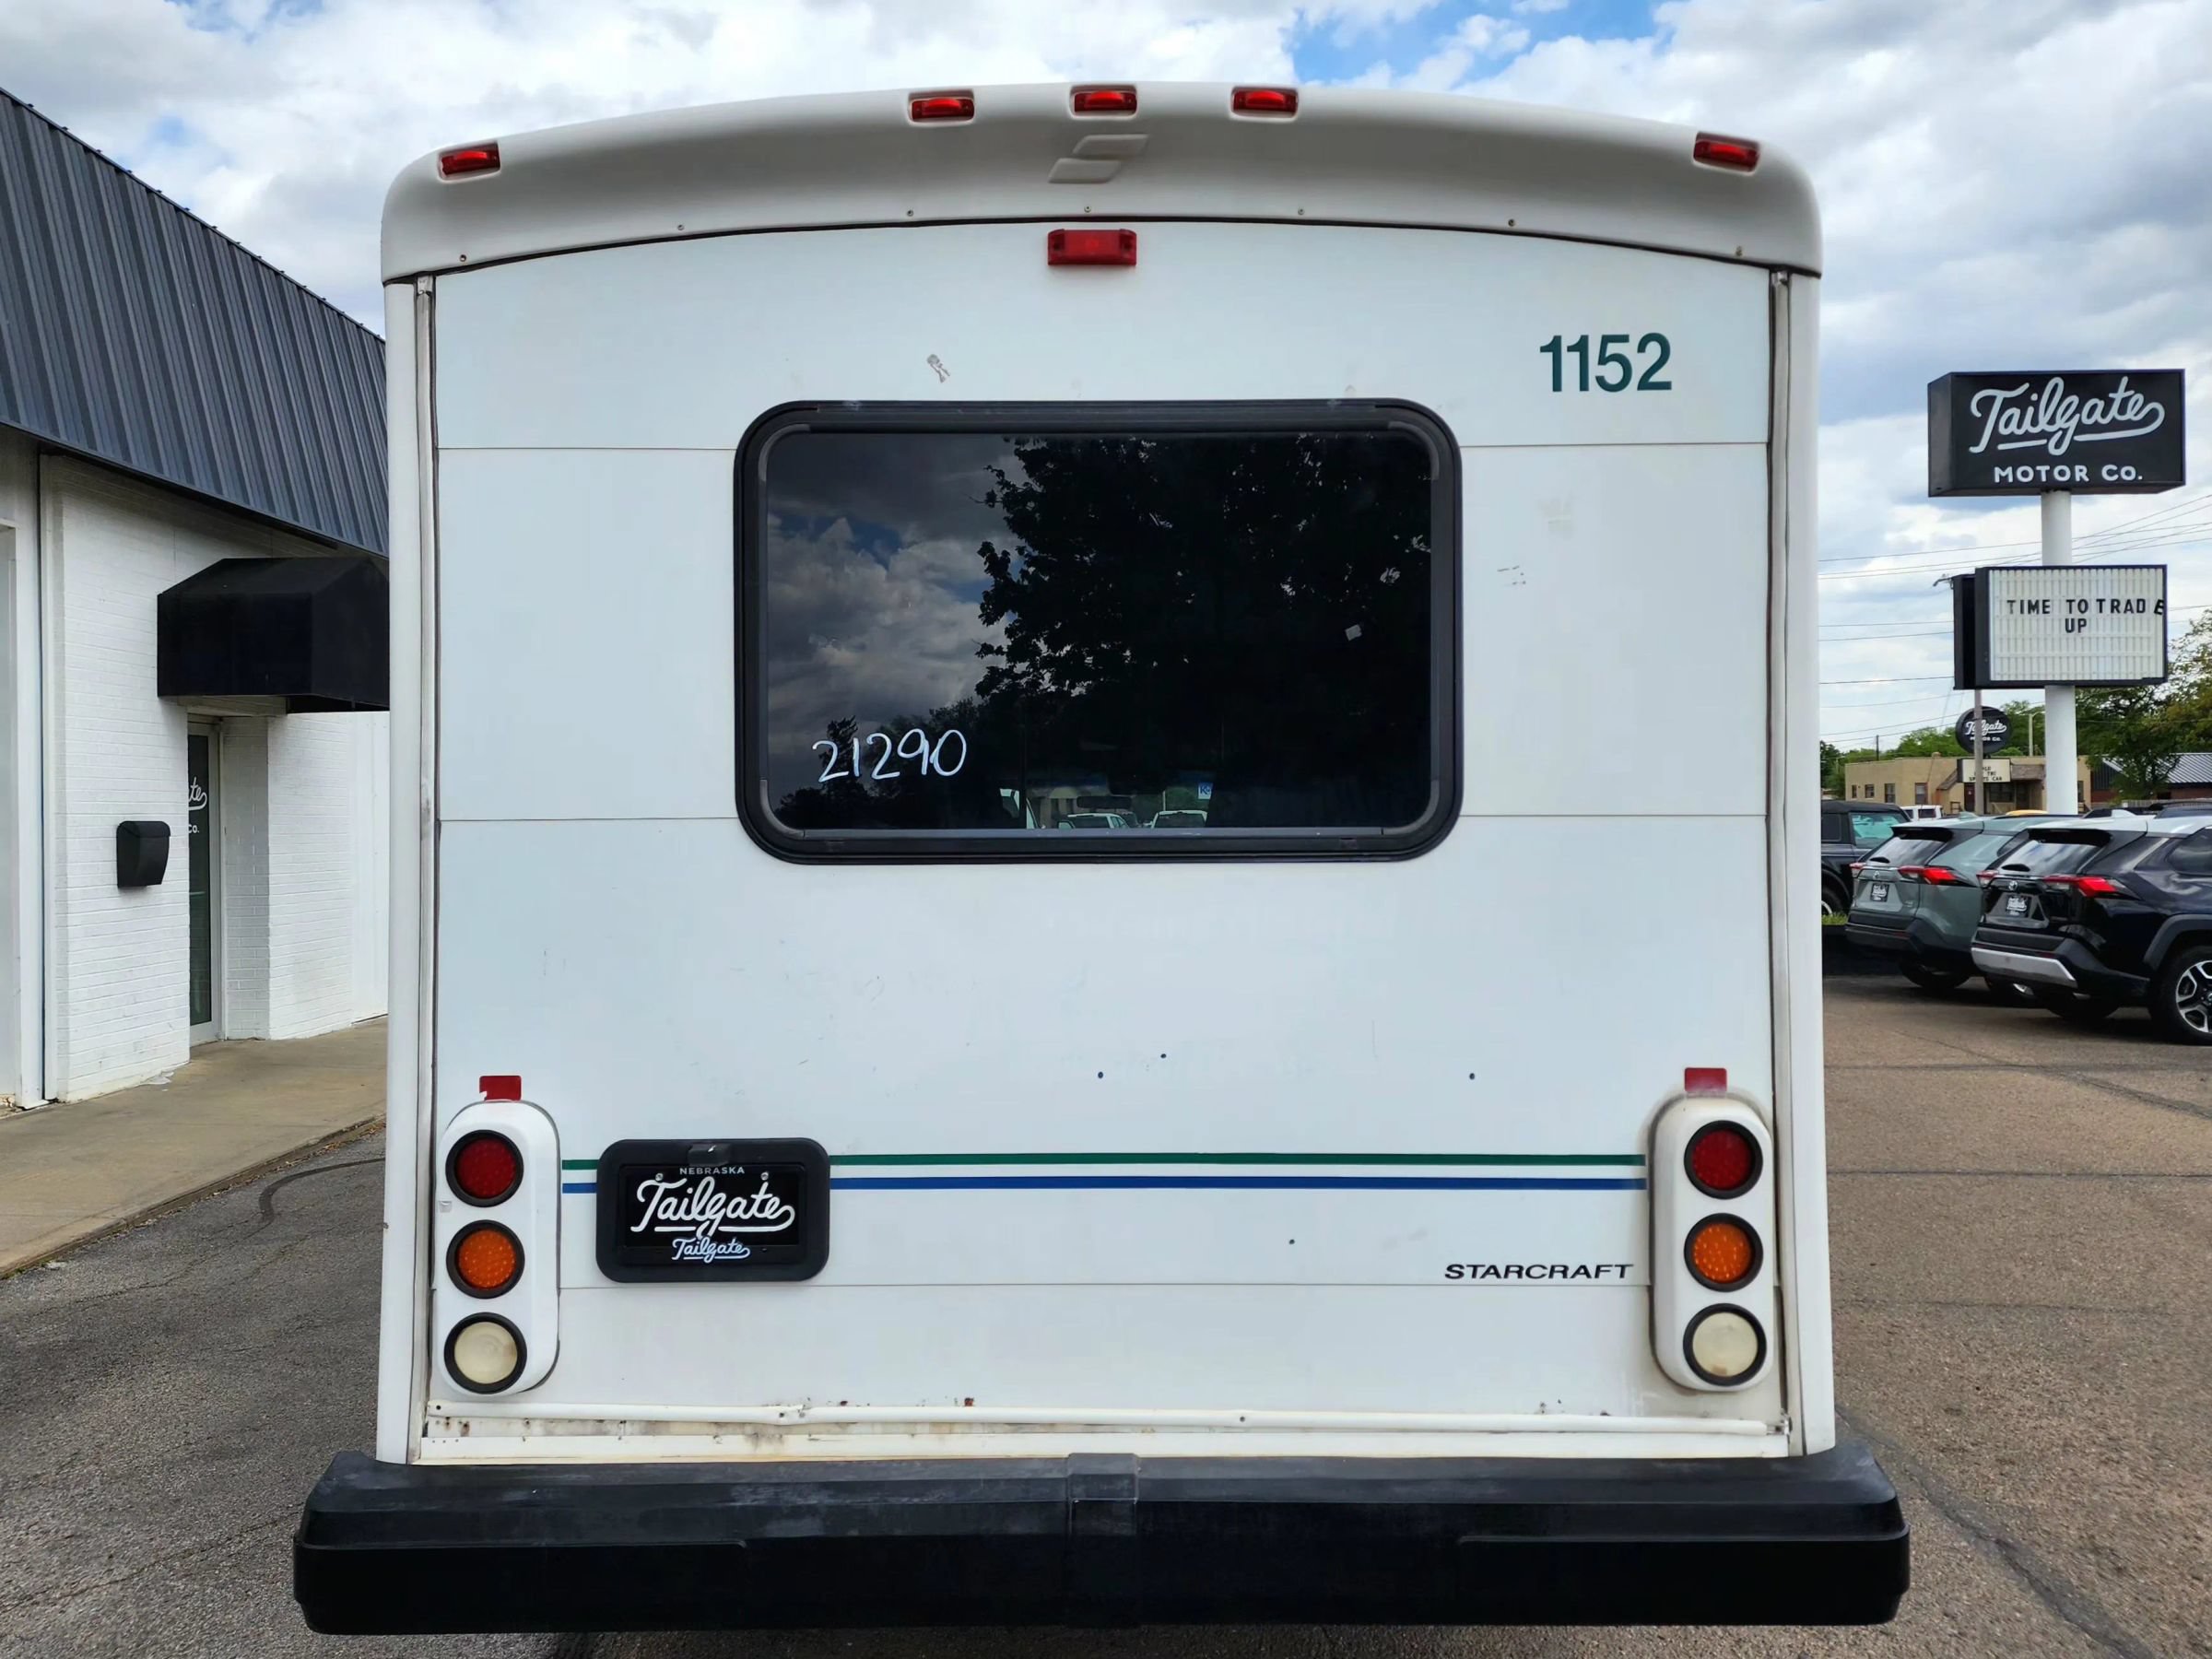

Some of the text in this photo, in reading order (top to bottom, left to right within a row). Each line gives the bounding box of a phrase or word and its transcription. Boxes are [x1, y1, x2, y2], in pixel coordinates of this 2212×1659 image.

[1539, 332, 1672, 393] 1152
[1969, 376, 2165, 455] Tailgate
[1994, 465, 2089, 483] MOTOR
[2006, 599, 2051, 615] TIME
[2065, 599, 2089, 615] TO
[2065, 618, 2088, 633] UP
[812, 728, 967, 782] 21290
[679, 1166, 746, 1175] NEBRASKA
[630, 1176, 795, 1240] Tailgate
[671, 1236, 751, 1264] Tailgate
[1444, 1264, 1634, 1279] STARCRAFT
